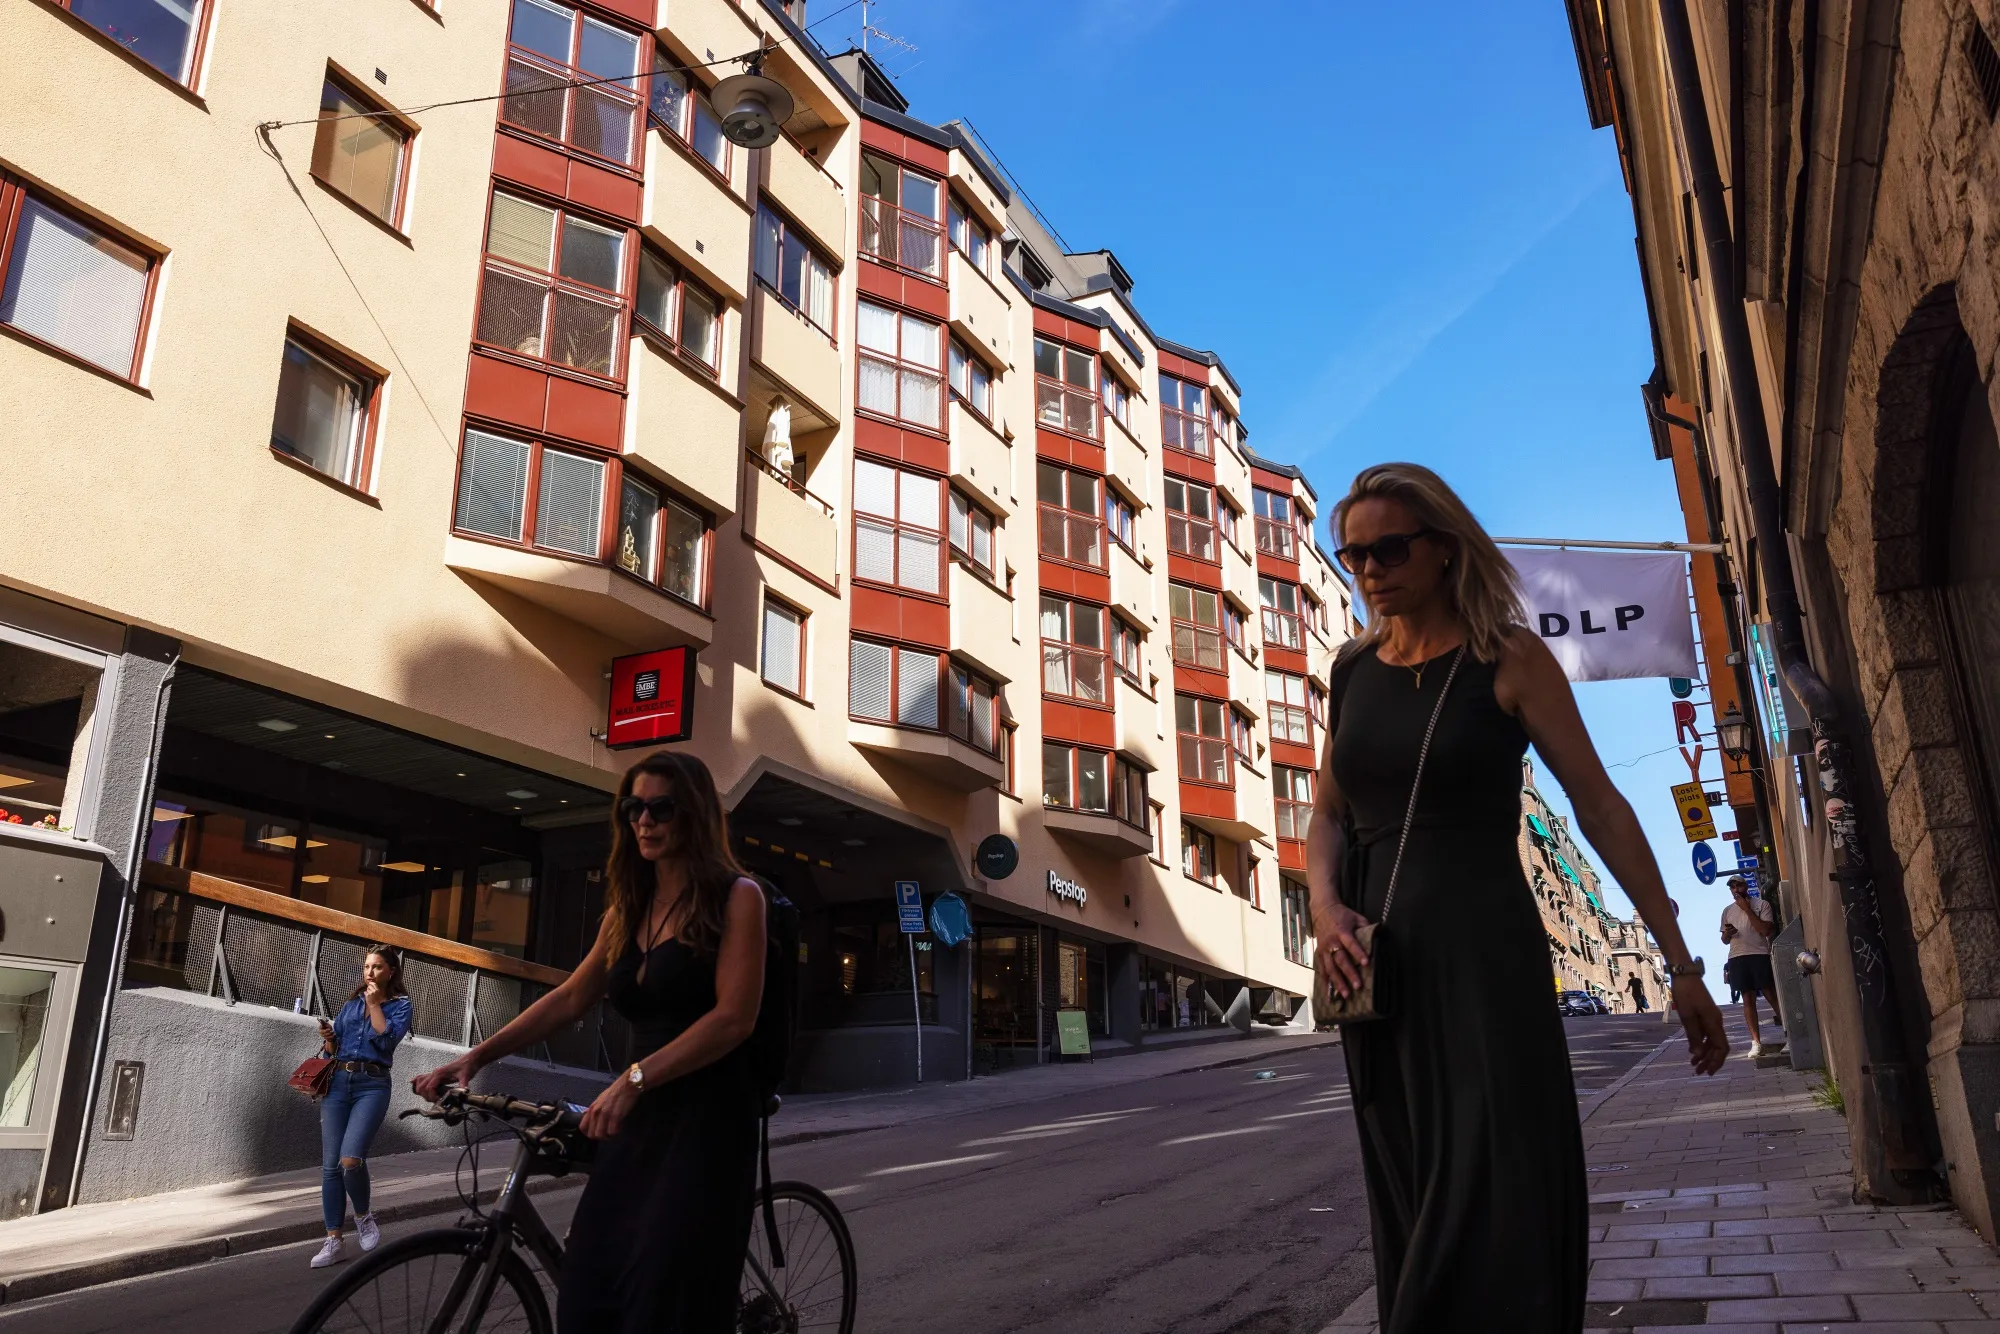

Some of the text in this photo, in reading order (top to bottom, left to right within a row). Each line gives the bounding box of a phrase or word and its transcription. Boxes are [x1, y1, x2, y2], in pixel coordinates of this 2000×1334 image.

[1538, 604, 1645, 638] DLP
[638, 682, 655, 691] MBE
[616, 707, 635, 716] MAIL
[636, 702, 659, 713] BOXES
[1679, 793, 1701, 804] plats
[1049, 870, 1087, 907] Pepstop
